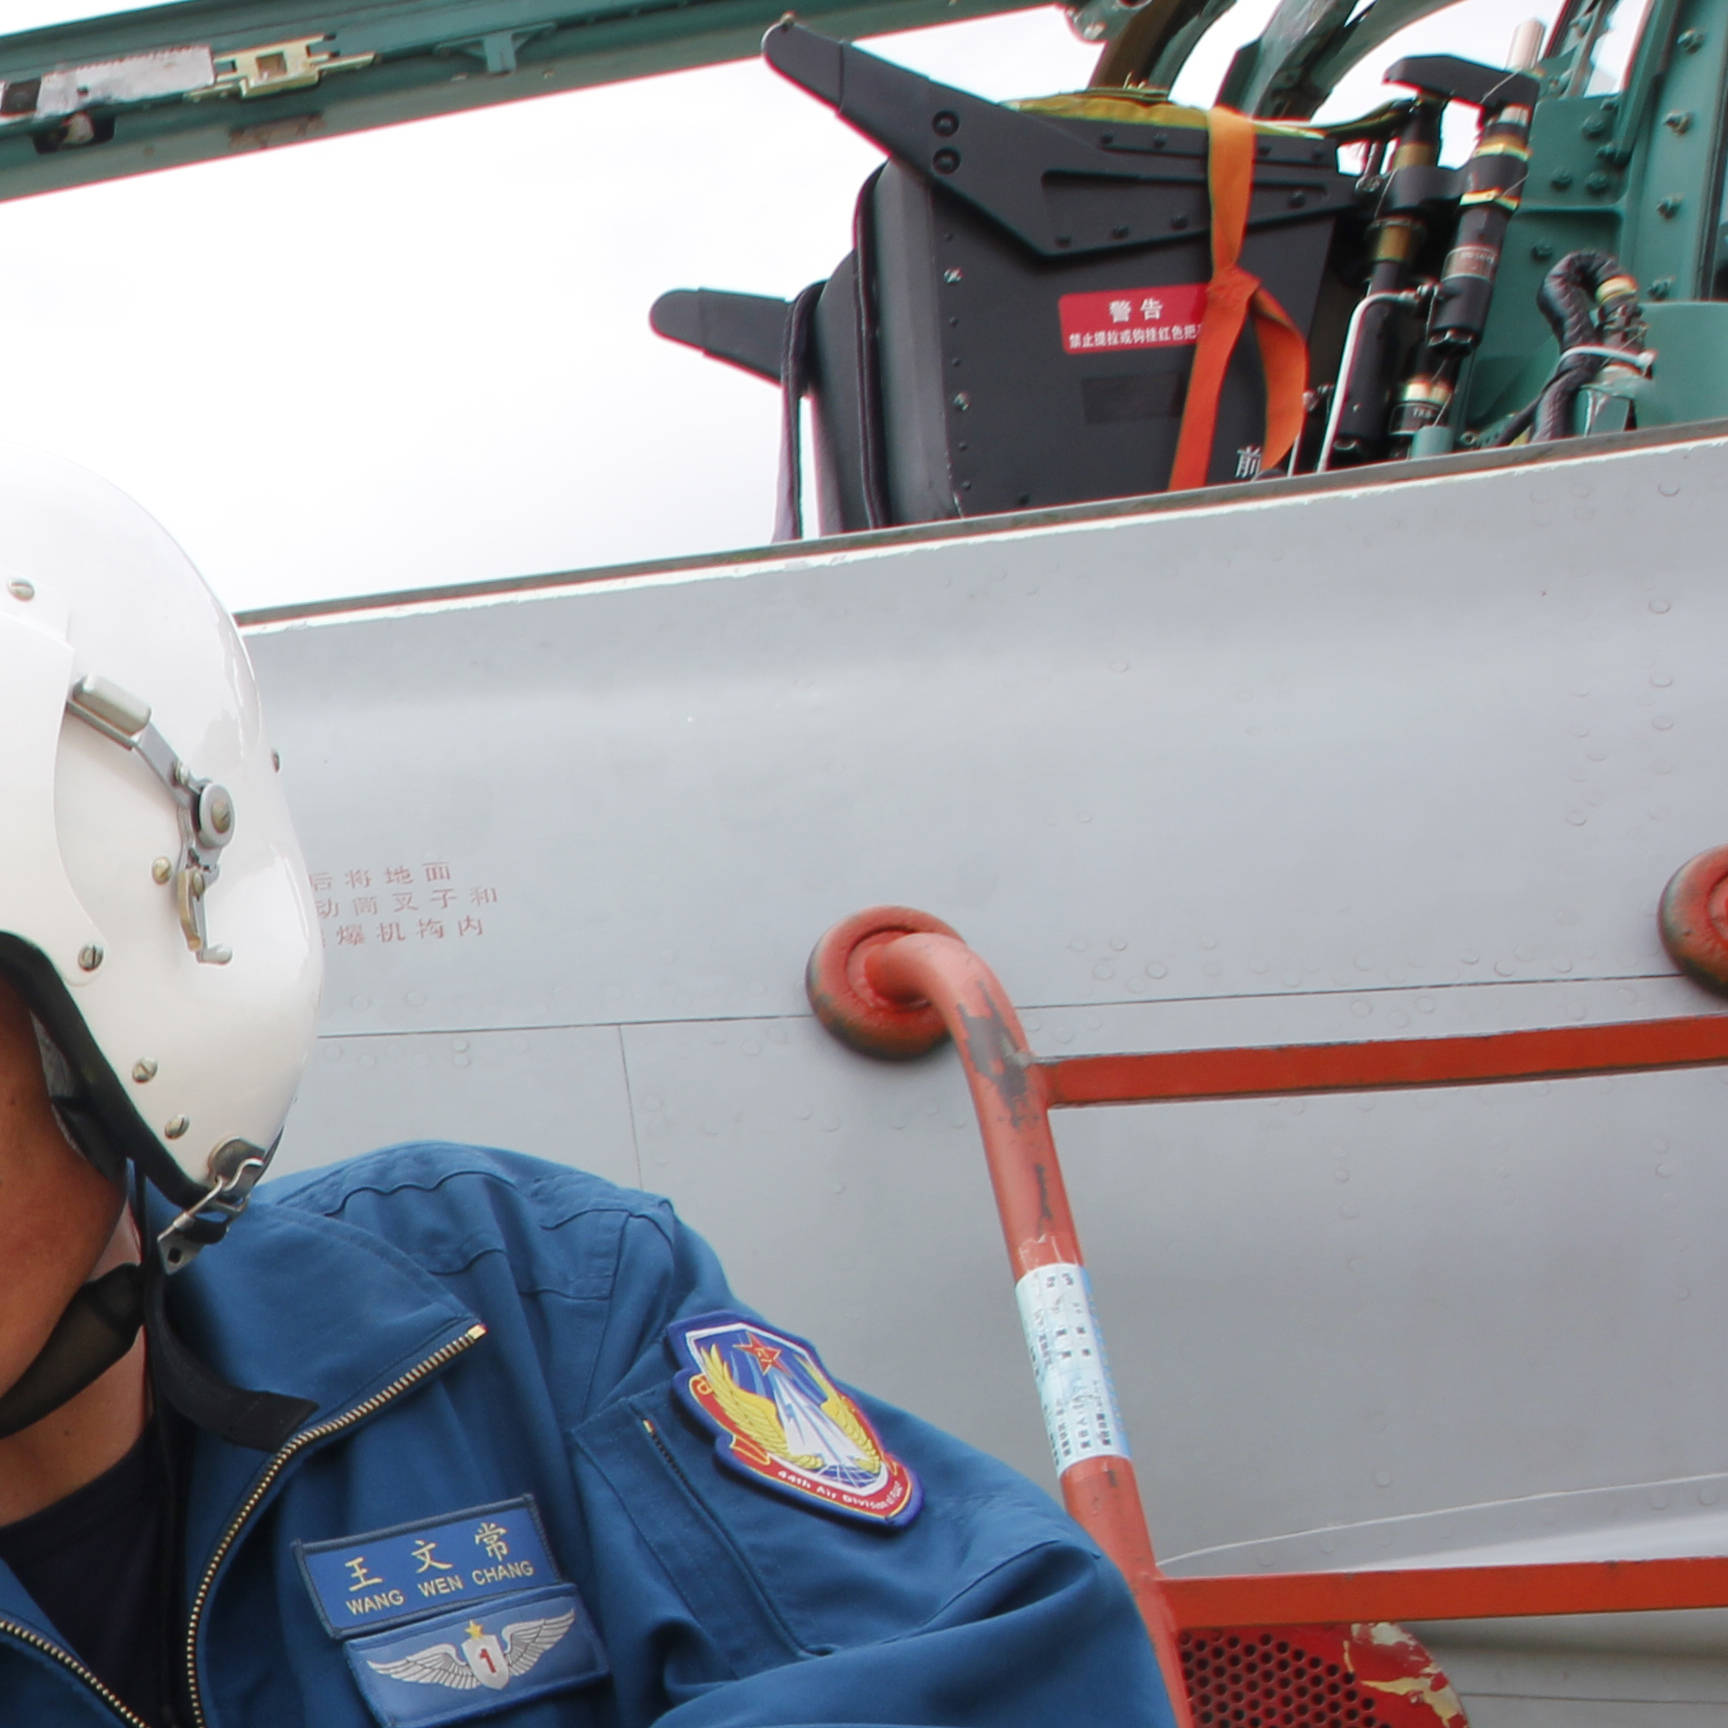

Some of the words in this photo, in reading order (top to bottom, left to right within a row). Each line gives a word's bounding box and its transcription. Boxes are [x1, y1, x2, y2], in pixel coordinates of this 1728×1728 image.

[1109, 297, 1163, 323] 警告
[1069, 324, 1202, 349] 禁止提拉或钩挂红色把
[321, 915, 484, 949] 爆机构内
[345, 1522, 509, 1592] 王文常
[345, 1589, 404, 1616] WANG
[418, 1576, 464, 1597] WEN
[471, 1560, 534, 1586] CHANG
[479, 1648, 497, 1674] 1
